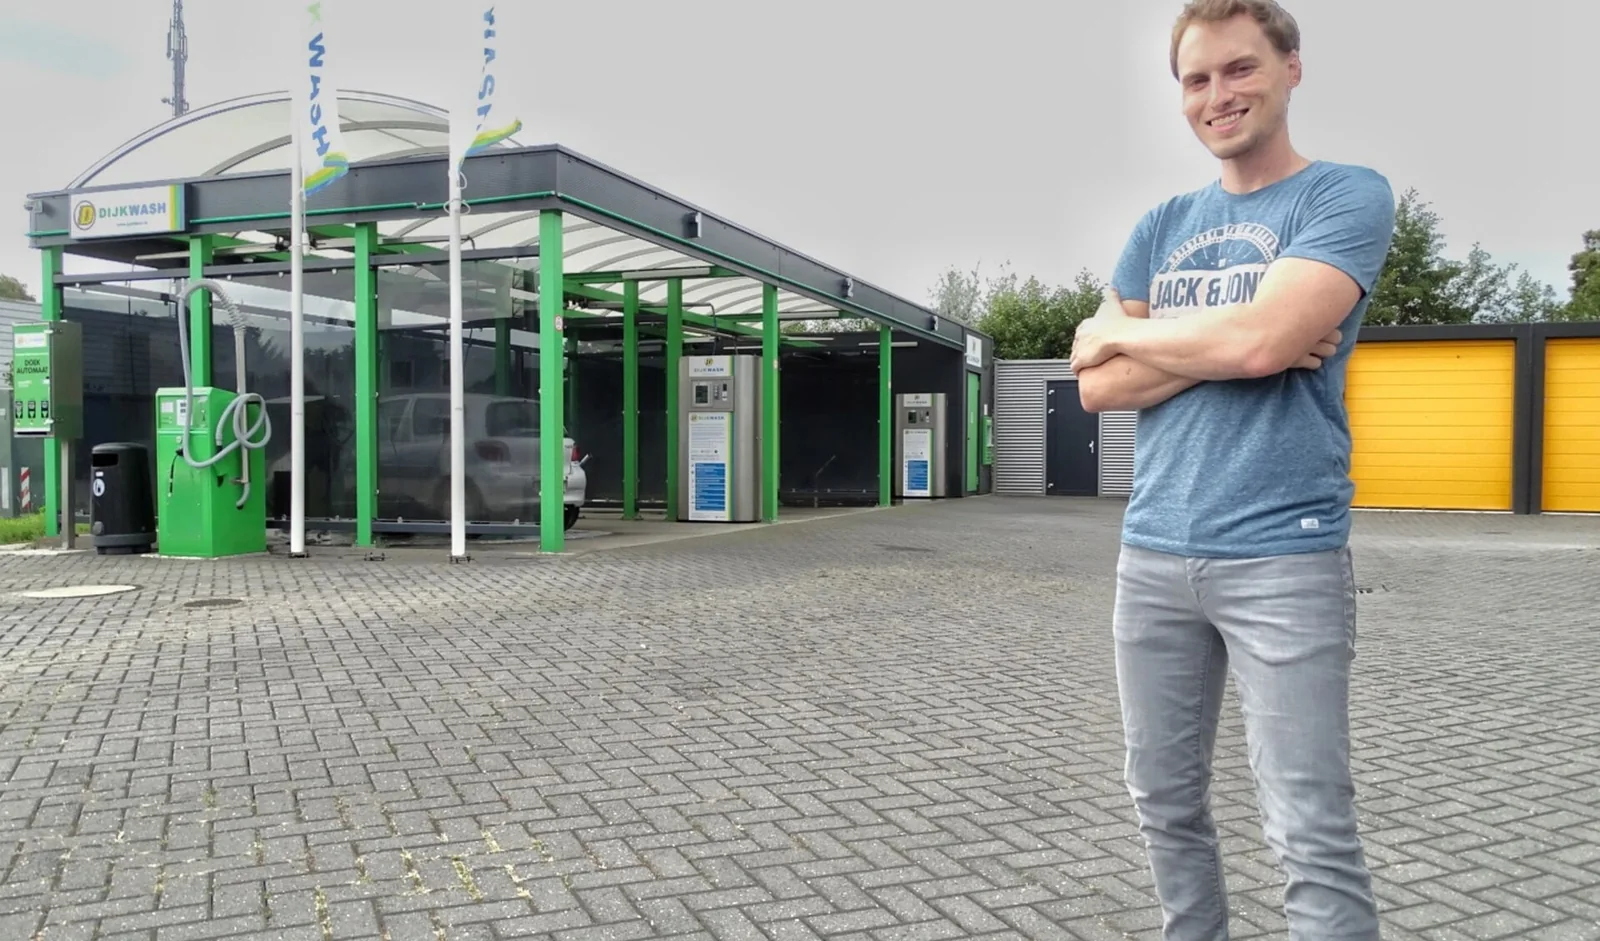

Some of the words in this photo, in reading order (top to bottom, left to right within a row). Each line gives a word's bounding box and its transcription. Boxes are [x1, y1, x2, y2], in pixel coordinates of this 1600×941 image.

[99, 202, 166, 218] DIJKWASH
[846, 277, 854, 298] 2
[1151, 277, 1203, 310] JACK
[1205, 278, 1221, 306] &
[16, 366, 49, 374] AUTOMAAT
